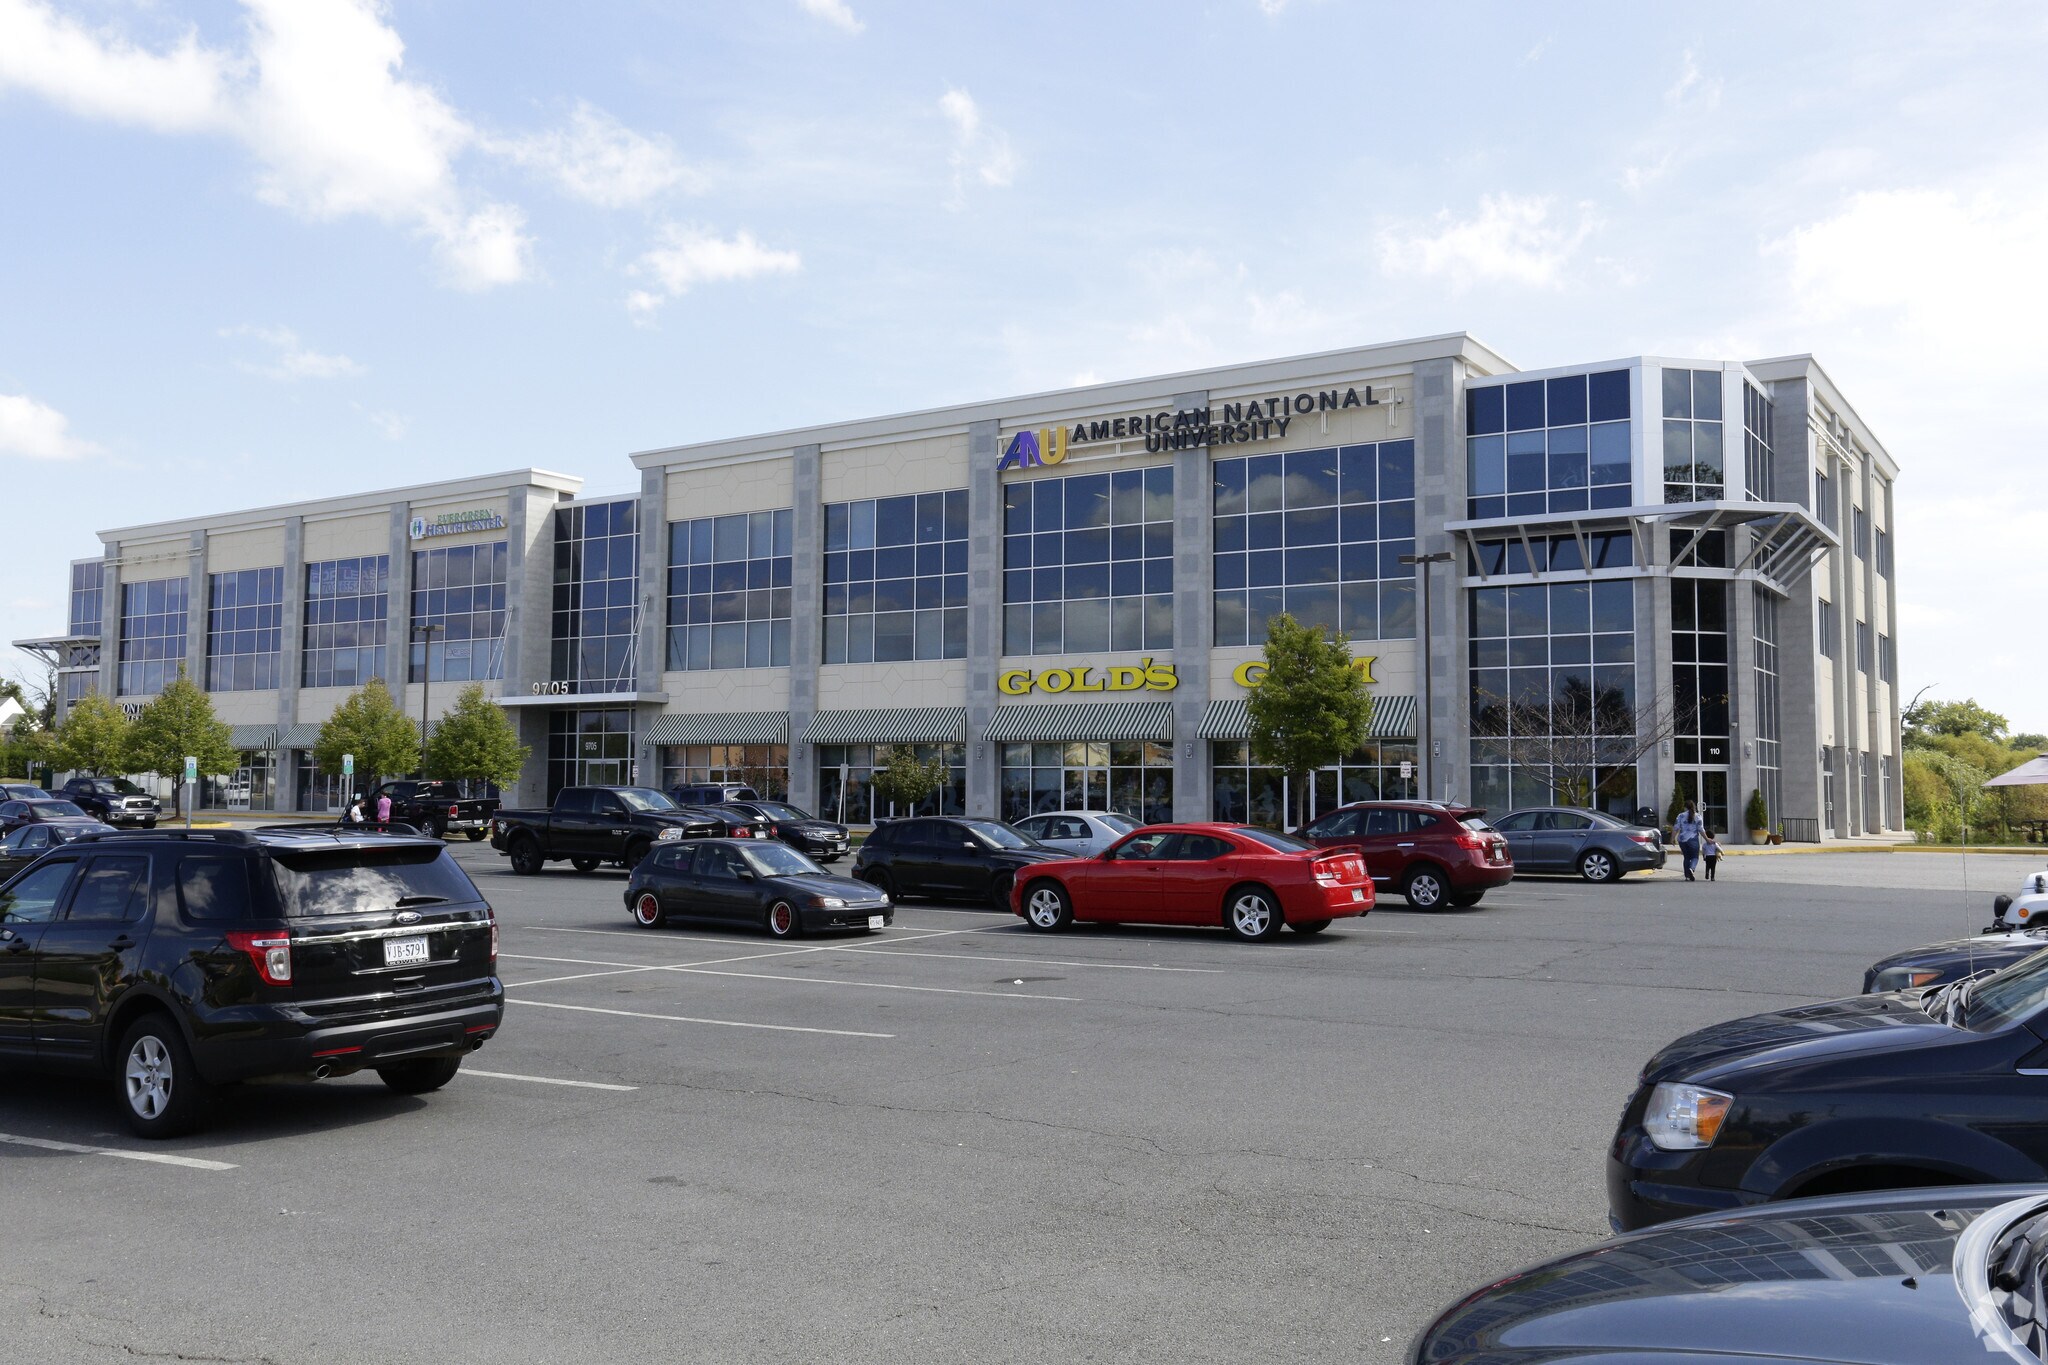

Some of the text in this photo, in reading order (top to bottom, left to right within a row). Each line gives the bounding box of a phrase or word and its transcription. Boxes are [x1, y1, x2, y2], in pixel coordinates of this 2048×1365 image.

[1072, 385, 1379, 442] AMERICAN NATIONAL
[1145, 416, 1291, 453] UNIVERSITY
[426, 515, 504, 537] HEALTH CENTER
[437, 508, 494, 525] EVERGREEN
[998, 656, 1378, 695] GOLD'S GM
[532, 681, 569, 696] 9705
[584, 741, 598, 751] 9705
[1710, 747, 1720, 755] 110
